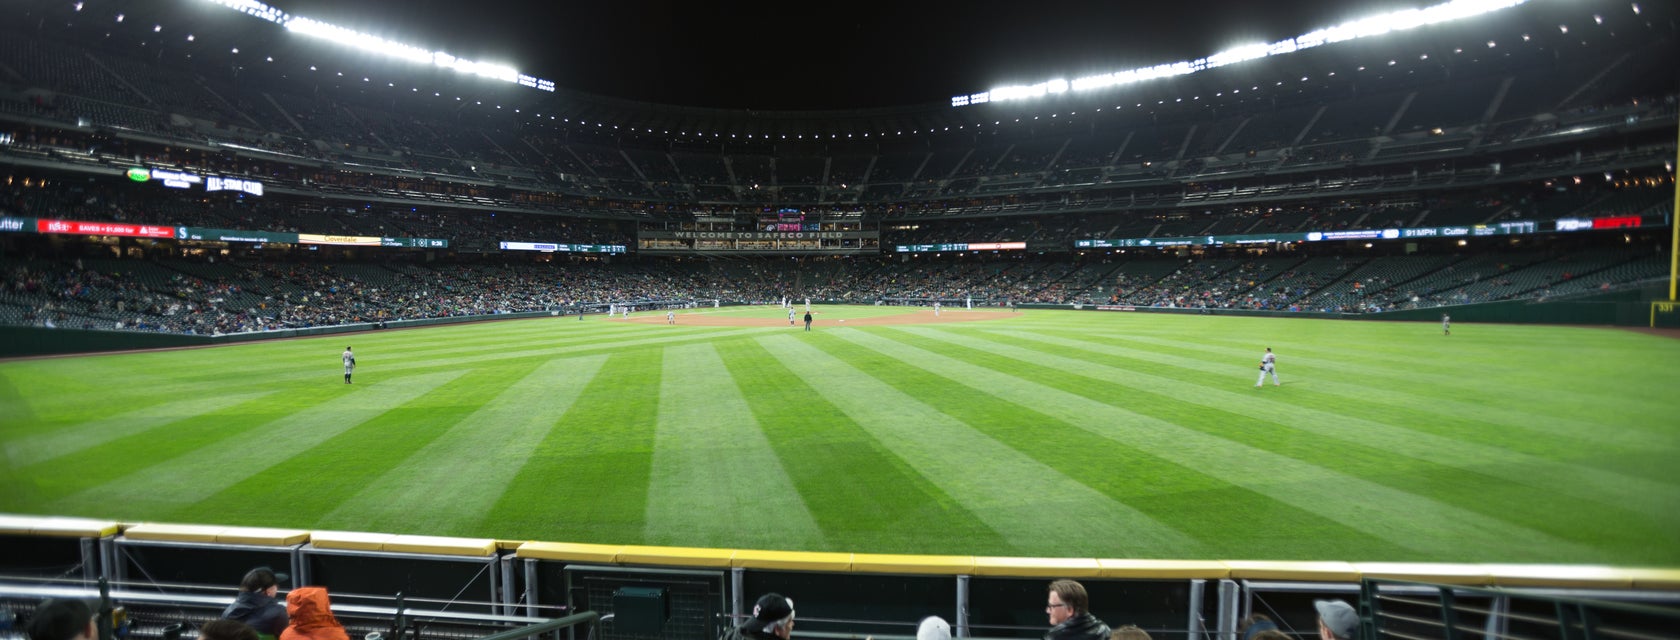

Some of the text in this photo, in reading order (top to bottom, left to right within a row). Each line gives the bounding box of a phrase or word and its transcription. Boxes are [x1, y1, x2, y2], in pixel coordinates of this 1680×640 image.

[243, 180, 263, 196] CLUB
[809, 231, 843, 239] FIELD
[1406, 229, 1416, 237] 91
[1416, 228, 1437, 236] MPH
[1443, 227, 1468, 236] Cutter
[324, 235, 357, 243] Cloverdale
